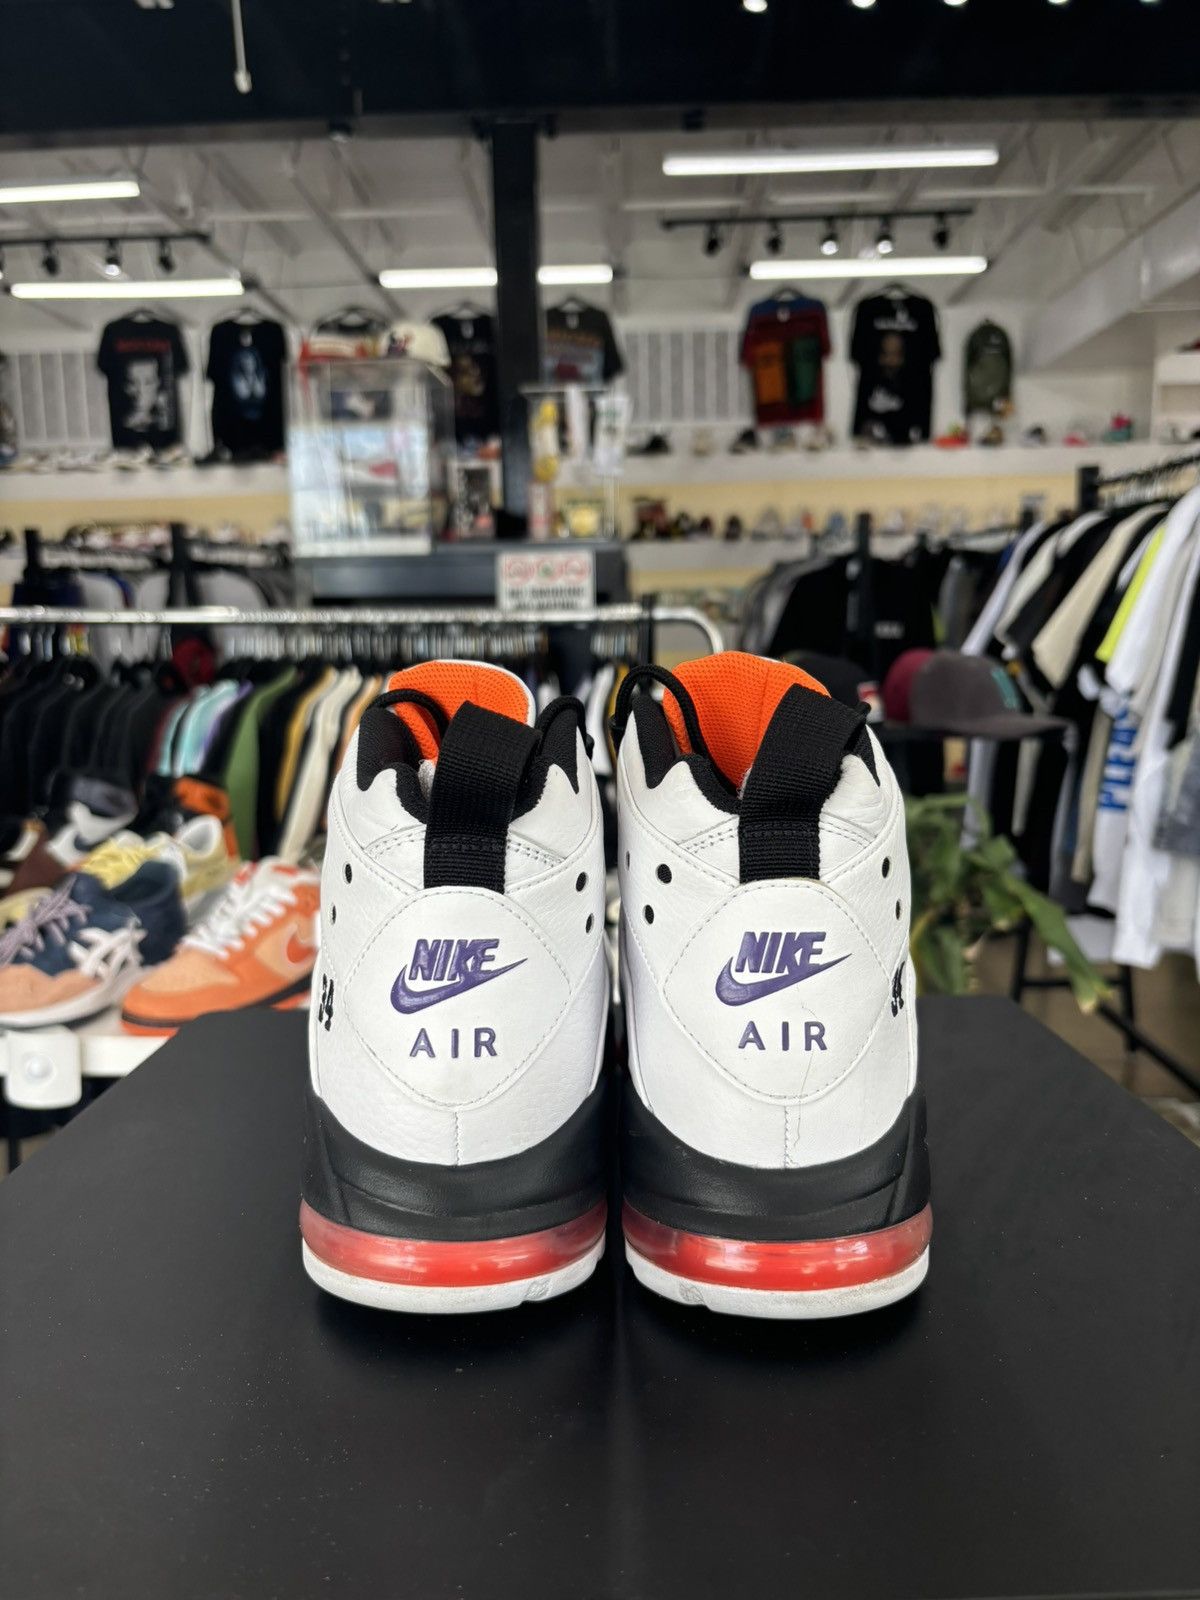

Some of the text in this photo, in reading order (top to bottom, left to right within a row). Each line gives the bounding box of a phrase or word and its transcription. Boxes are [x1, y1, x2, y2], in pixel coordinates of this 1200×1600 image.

[408, 938, 500, 981] NIKE
[734, 931, 827, 974] NIKE
[409, 1027, 498, 1059] AIR
[738, 1020, 828, 1051] AIR
